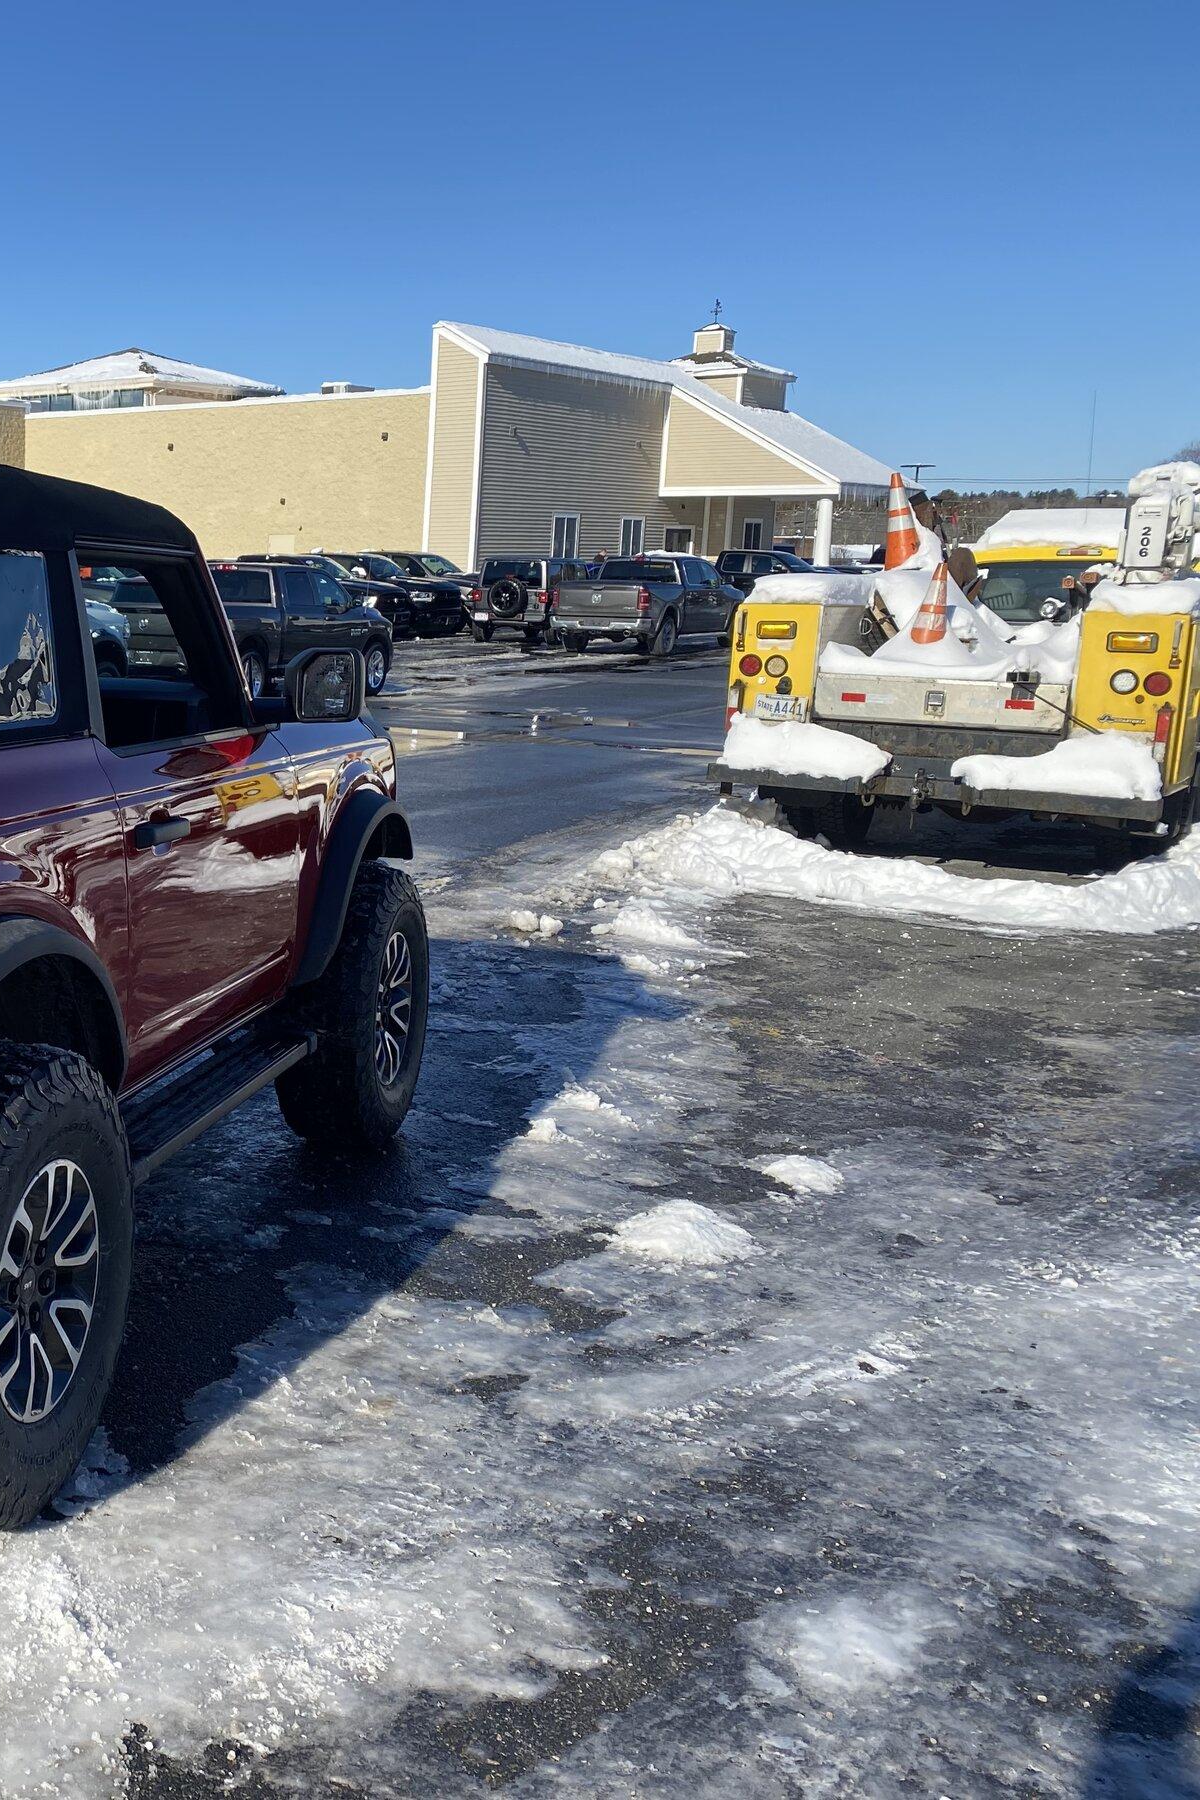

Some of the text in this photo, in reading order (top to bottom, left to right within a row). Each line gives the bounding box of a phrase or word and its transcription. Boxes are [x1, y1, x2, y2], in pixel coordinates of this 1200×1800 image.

[1139, 526, 1152, 558] 206
[757, 700, 773, 713] STATE
[774, 701, 803, 717] A441
